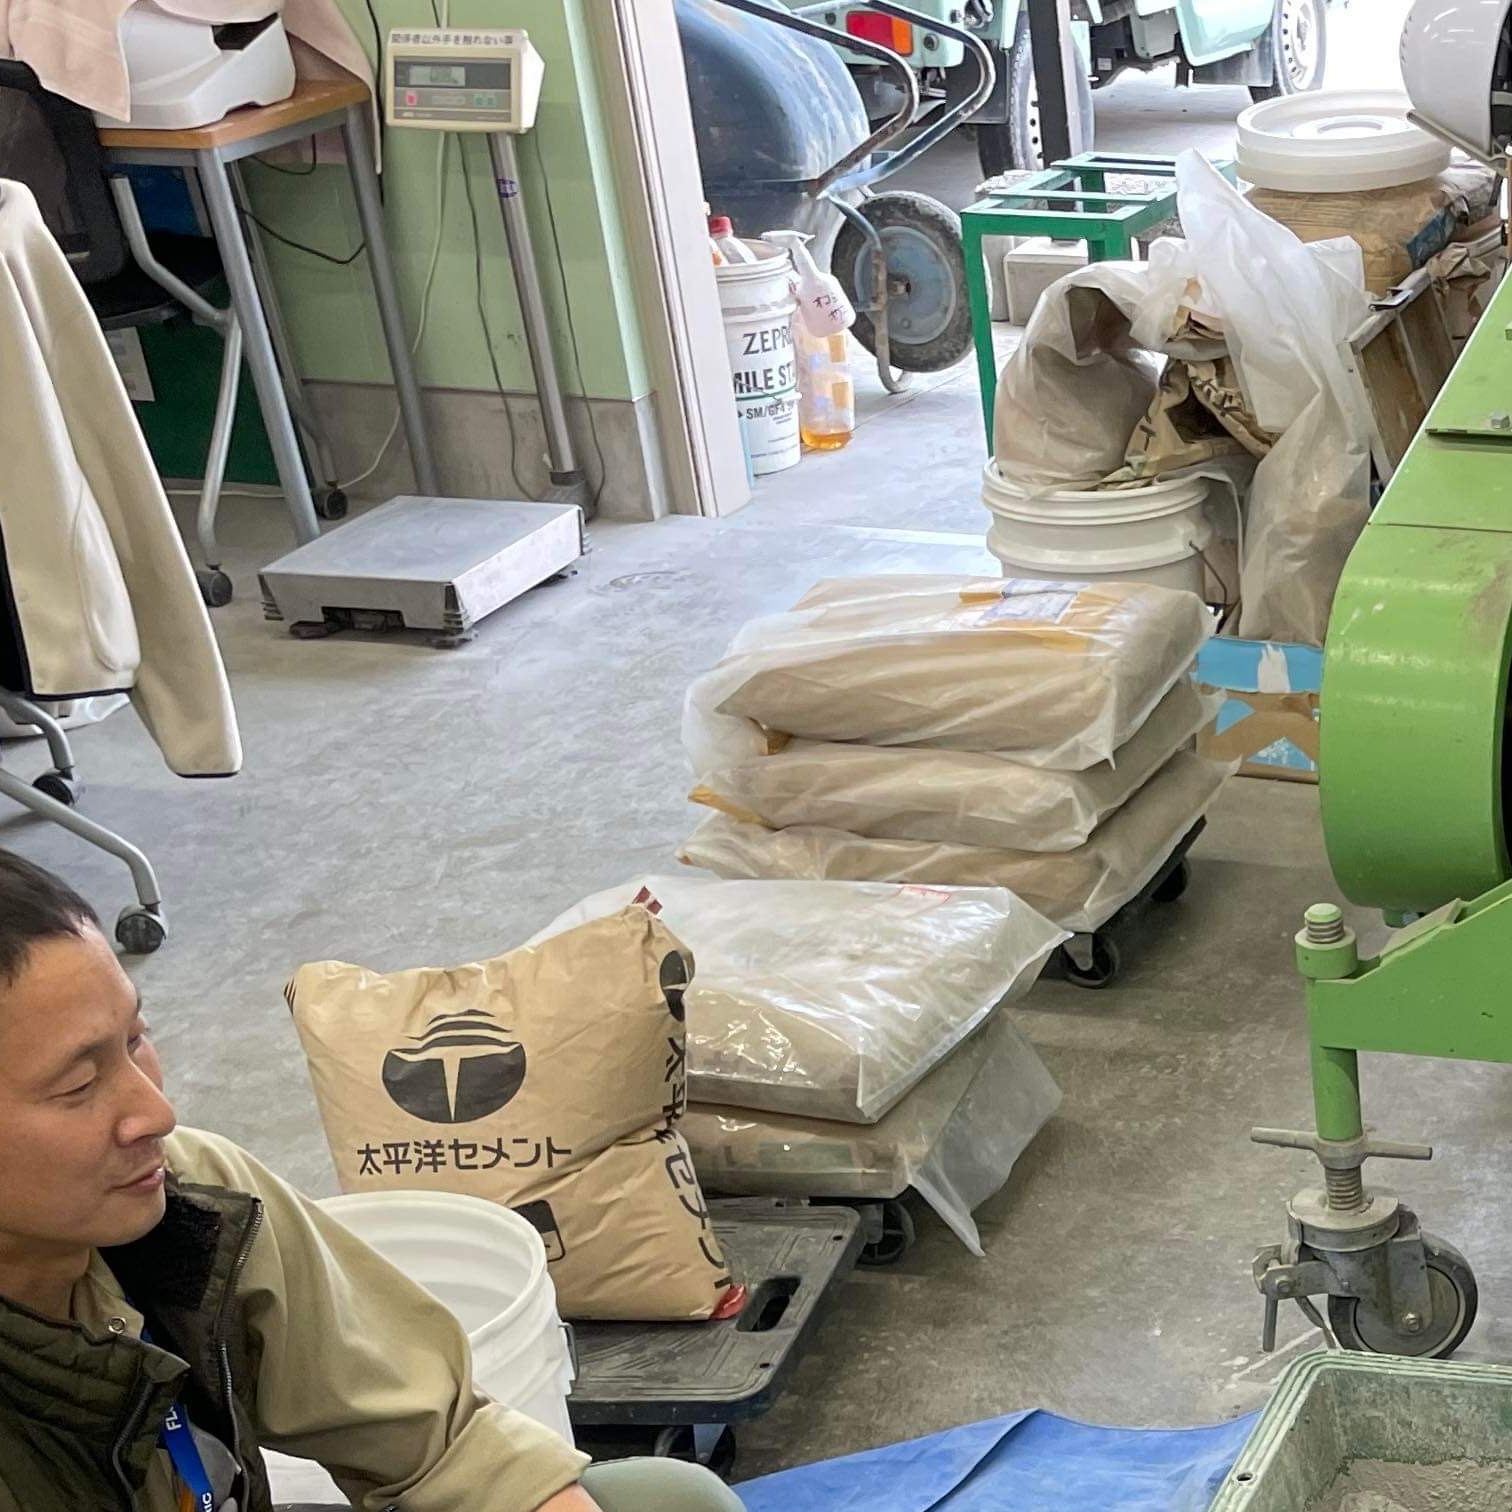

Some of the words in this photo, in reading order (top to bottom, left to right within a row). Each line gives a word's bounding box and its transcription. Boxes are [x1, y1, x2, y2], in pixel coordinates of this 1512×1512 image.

[778, 363, 795, 387] ST
[356, 1136, 572, 1176] 太平洋セメント
[165, 1406, 182, 1431] FL
